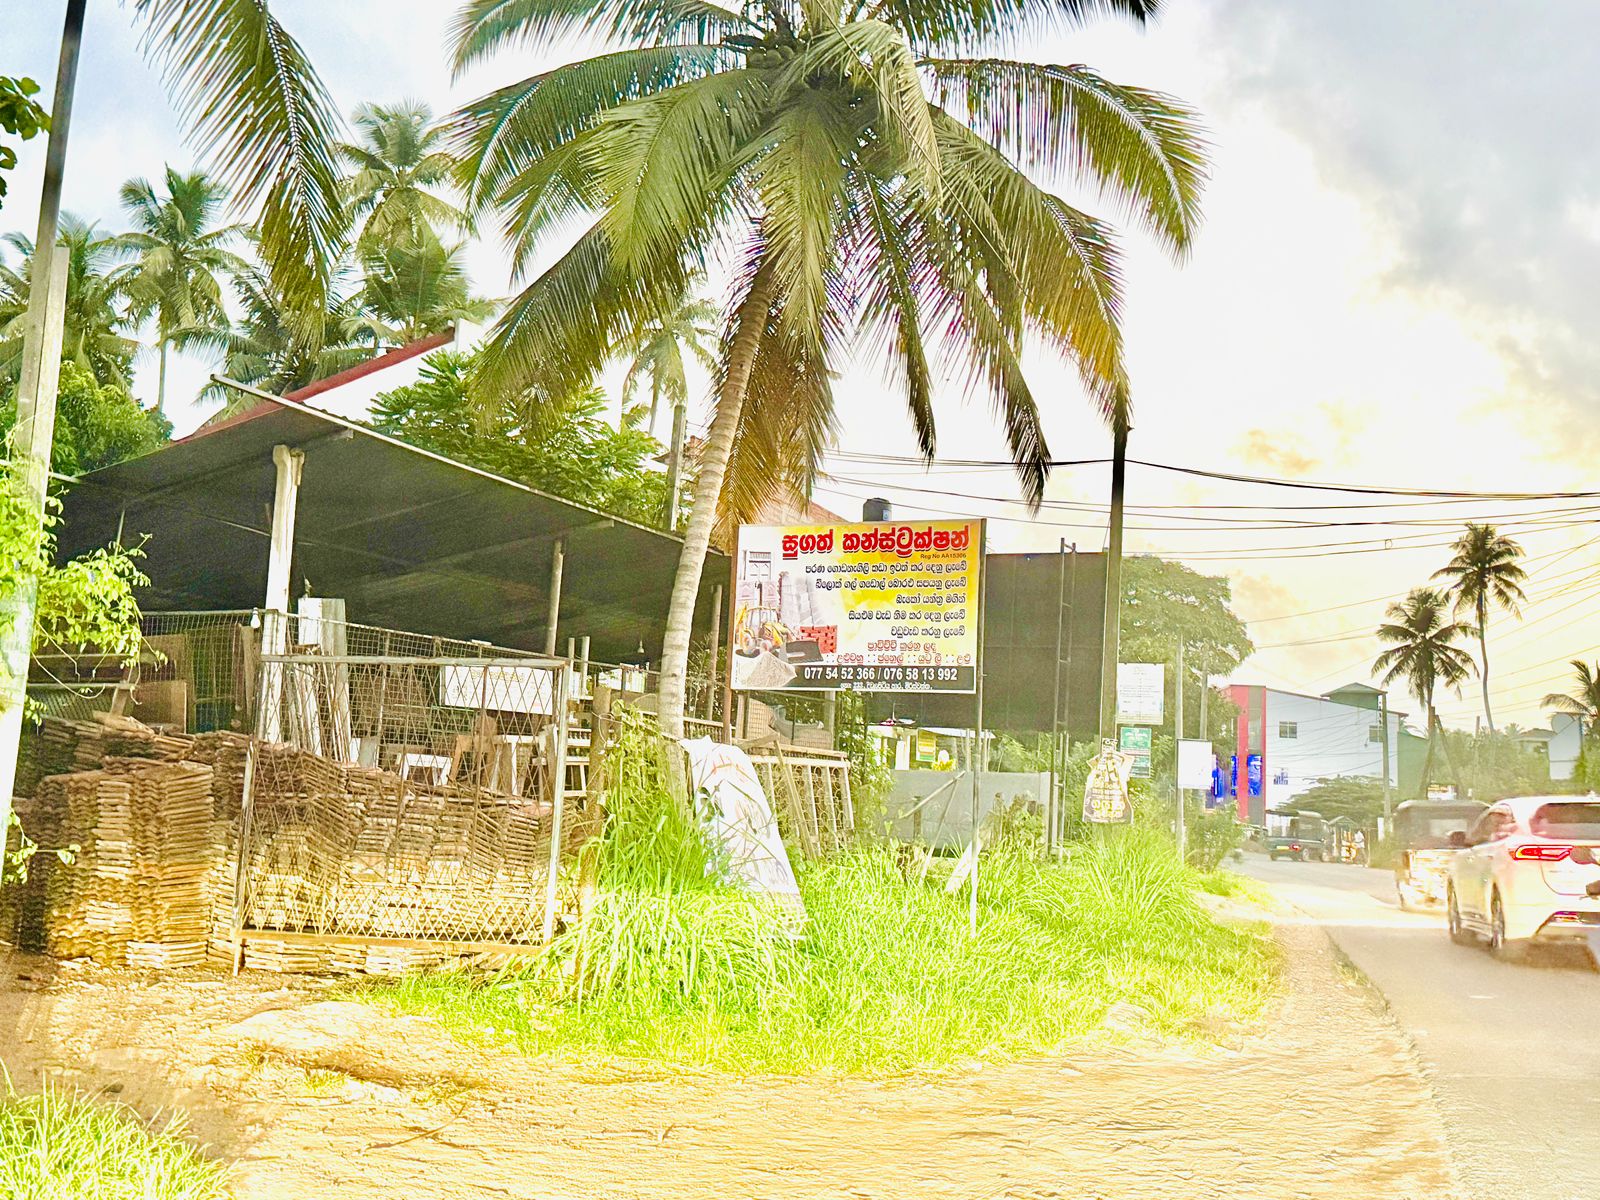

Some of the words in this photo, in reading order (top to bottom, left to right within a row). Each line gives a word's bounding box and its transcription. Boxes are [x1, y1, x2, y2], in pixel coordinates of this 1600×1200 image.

[782, 528, 834, 560] සුගත්
[804, 667, 822, 680] 077
[825, 667, 838, 680] 54
[841, 667, 853, 680] 52
[856, 667, 875, 680] 366
[883, 667, 903, 681] 076
[906, 668, 919, 681] 58
[922, 668, 935, 681] 13
[937, 668, 958, 681] 992
